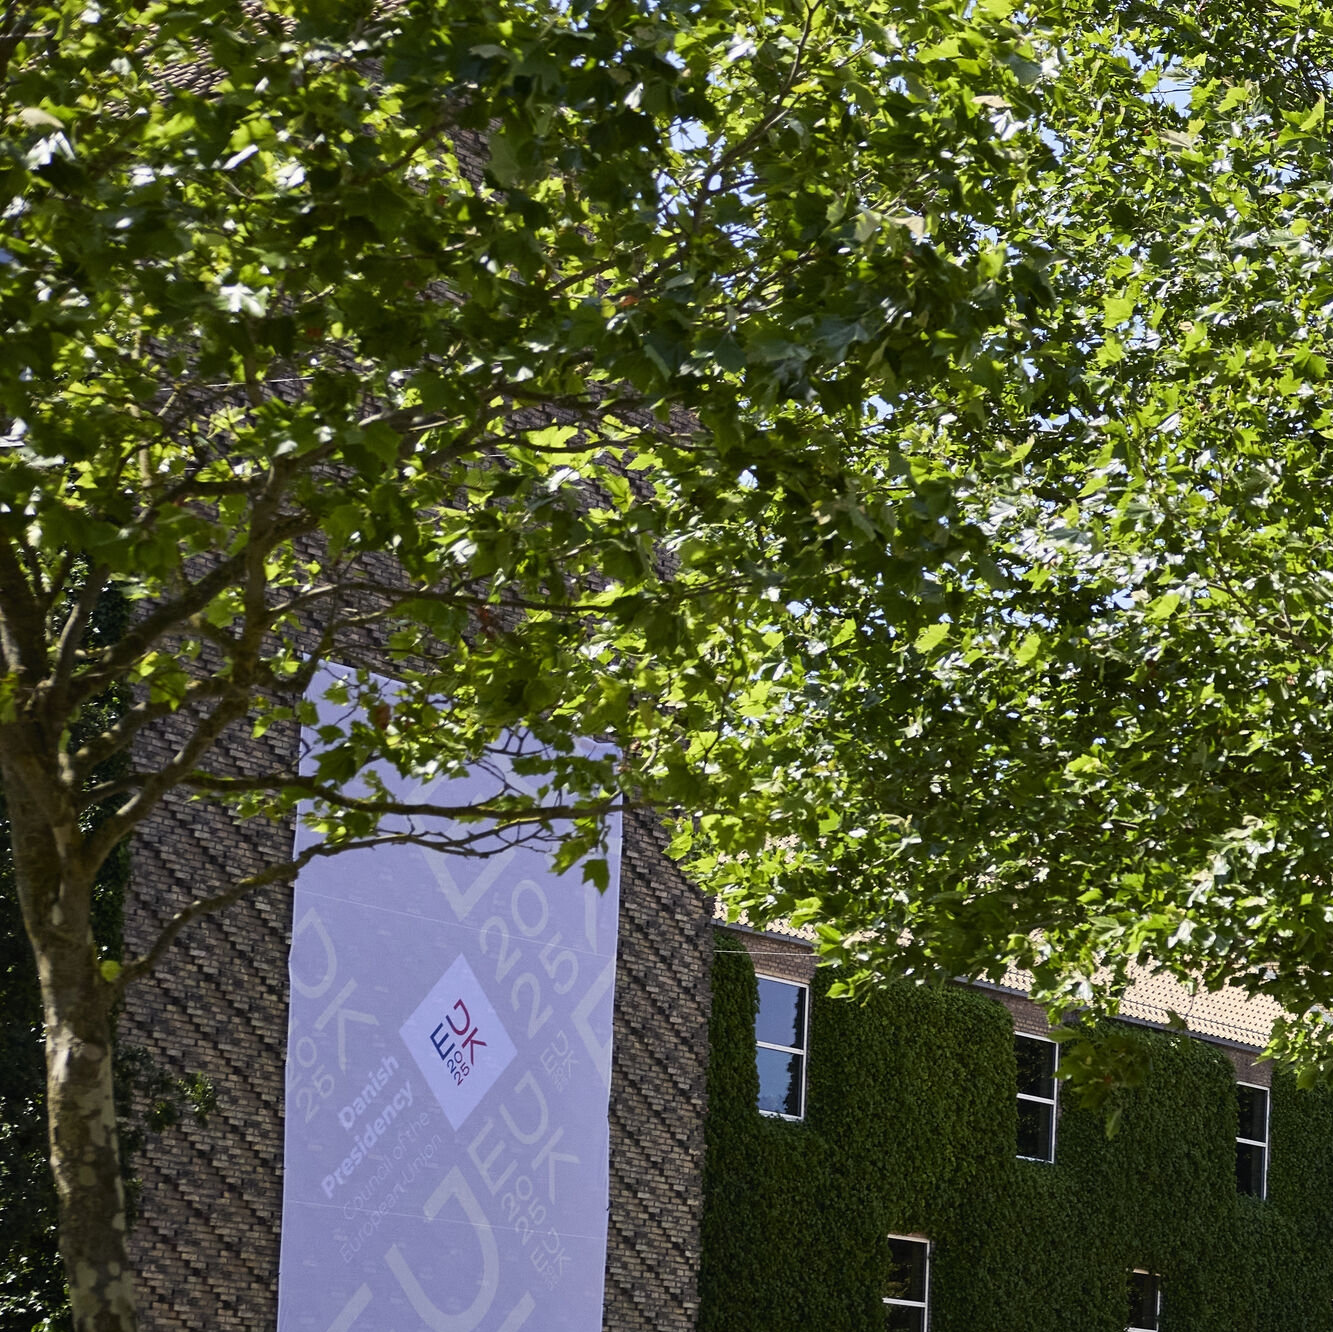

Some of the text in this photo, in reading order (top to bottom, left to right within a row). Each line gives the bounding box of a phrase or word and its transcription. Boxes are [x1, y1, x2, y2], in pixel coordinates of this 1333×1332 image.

[320, 1080, 414, 1199] Presidency
[337, 1054, 399, 1131] Danish
[340, 1134, 442, 1263] European Union
[344, 1153, 392, 1220] Council
